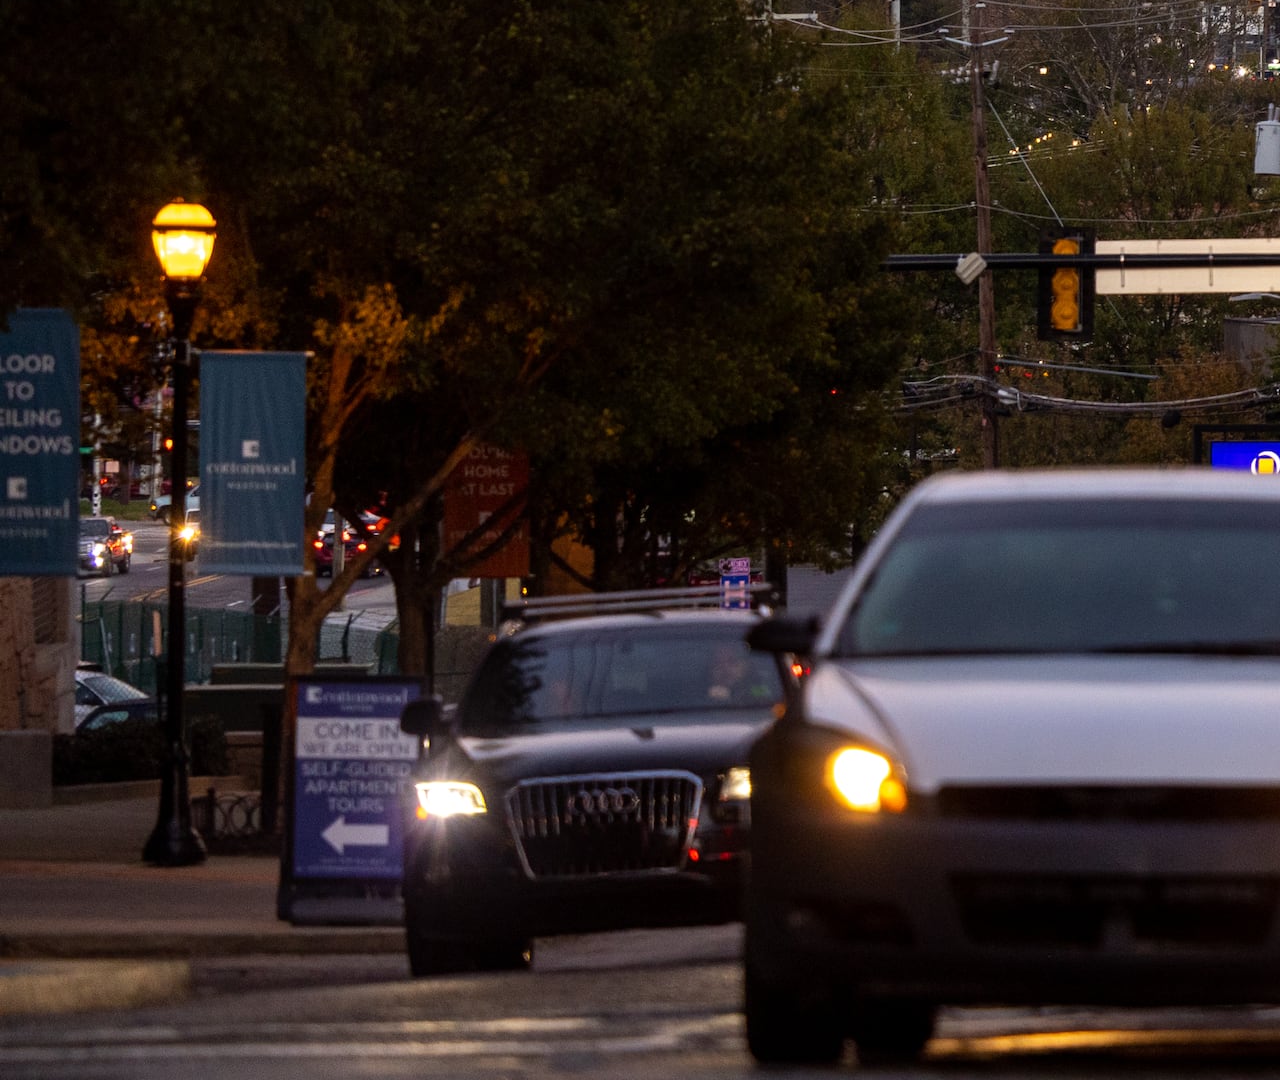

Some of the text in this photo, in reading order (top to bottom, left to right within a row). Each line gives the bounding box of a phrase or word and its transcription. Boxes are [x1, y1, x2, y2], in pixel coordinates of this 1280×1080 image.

[5, 380, 35, 401] TO
[464, 464, 511, 478] HOME
[479, 482, 516, 496] LAST
[315, 723, 400, 740] COME IN
[302, 743, 410, 755] WE ARE OPEN
[304, 780, 407, 795] APARTMENT
[328, 798, 384, 812] TOURS
